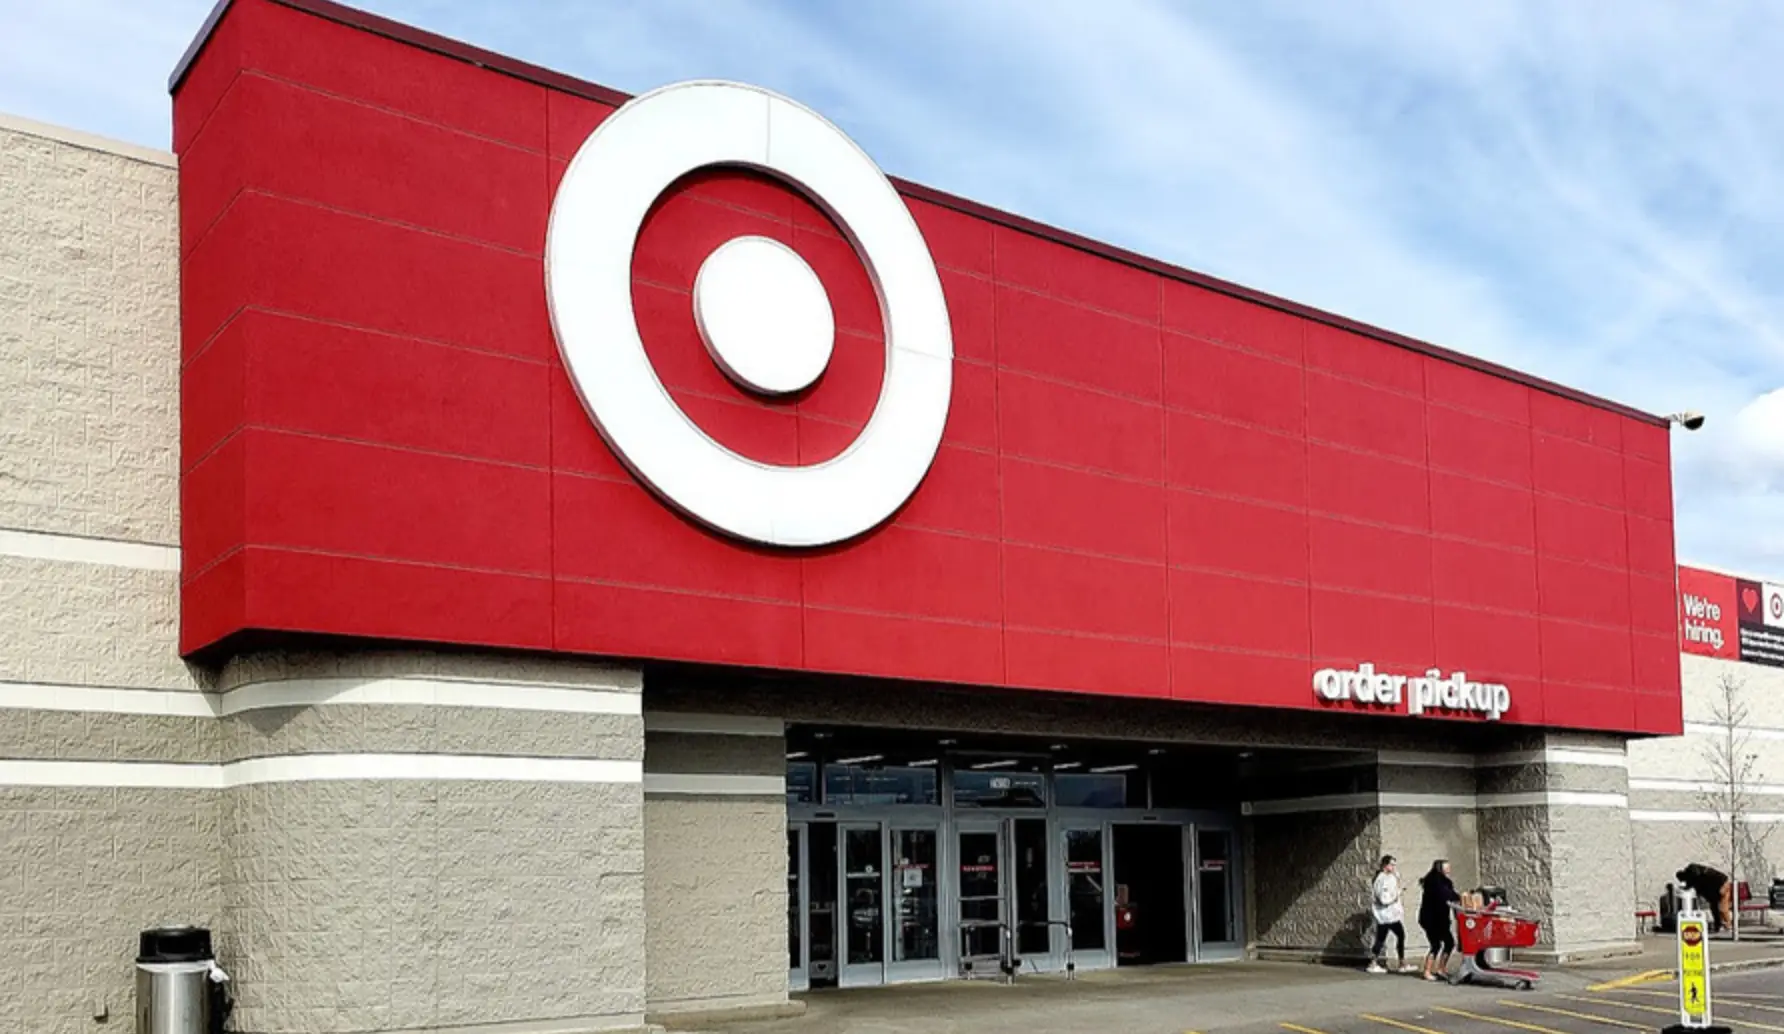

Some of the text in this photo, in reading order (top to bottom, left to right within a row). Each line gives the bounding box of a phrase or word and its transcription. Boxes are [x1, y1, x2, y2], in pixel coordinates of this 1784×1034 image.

[1683, 592, 1721, 621] We're
[1313, 662, 1511, 721] order pickup
